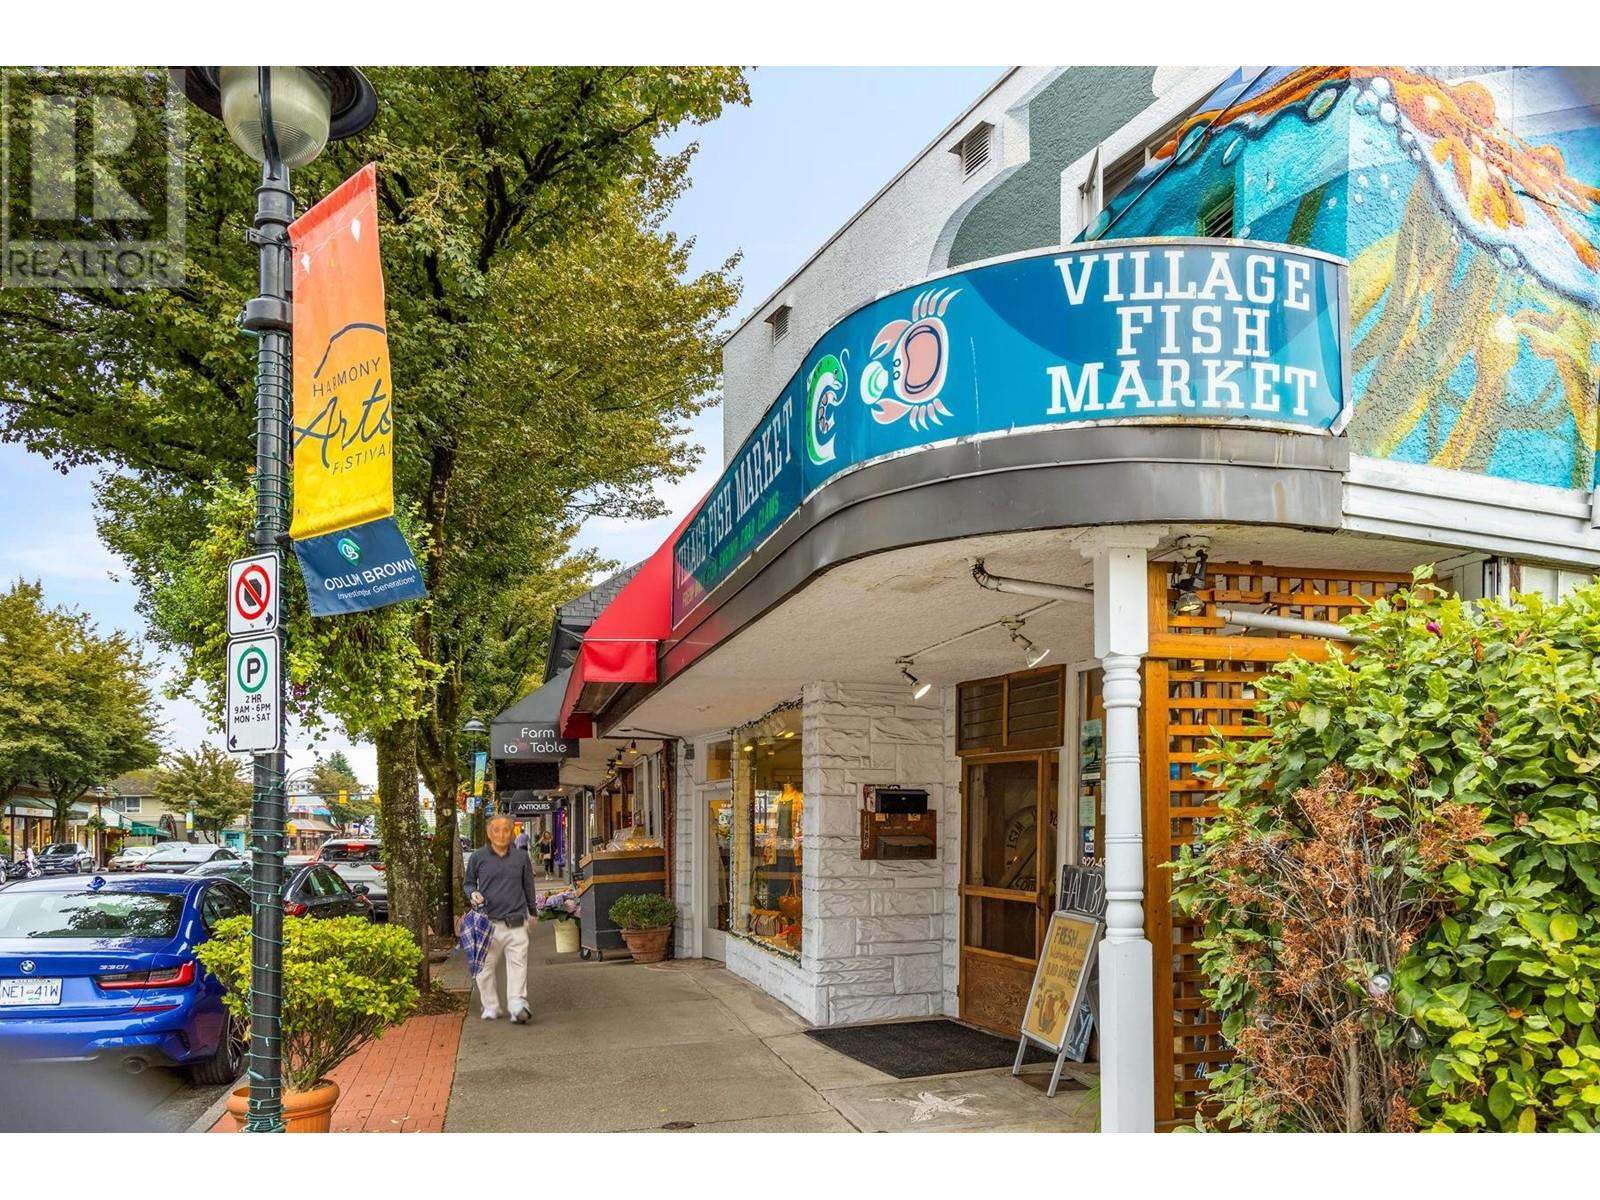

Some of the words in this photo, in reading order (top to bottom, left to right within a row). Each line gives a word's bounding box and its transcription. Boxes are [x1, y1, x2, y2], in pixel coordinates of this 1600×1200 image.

[1054, 250, 1310, 312] VILLAGE
[1116, 305, 1271, 358] FISH
[313, 358, 380, 398] HARMONY
[1046, 358, 1317, 416] MARKET
[708, 482, 733, 555] FISH
[734, 397, 793, 523] MARKET
[362, 557, 417, 584] BROWN
[245, 695, 250, 703] 2
[251, 694, 262, 703] HR
[234, 705, 250, 714] 9AM
[255, 703, 271, 712] 6PM
[234, 715, 250, 723] MON
[256, 713, 271, 722] SAT
[521, 727, 555, 738] Farm
[504, 743, 518, 753] to
[529, 742, 568, 753] Table
[517, 803, 551, 811] ANTIQUES
